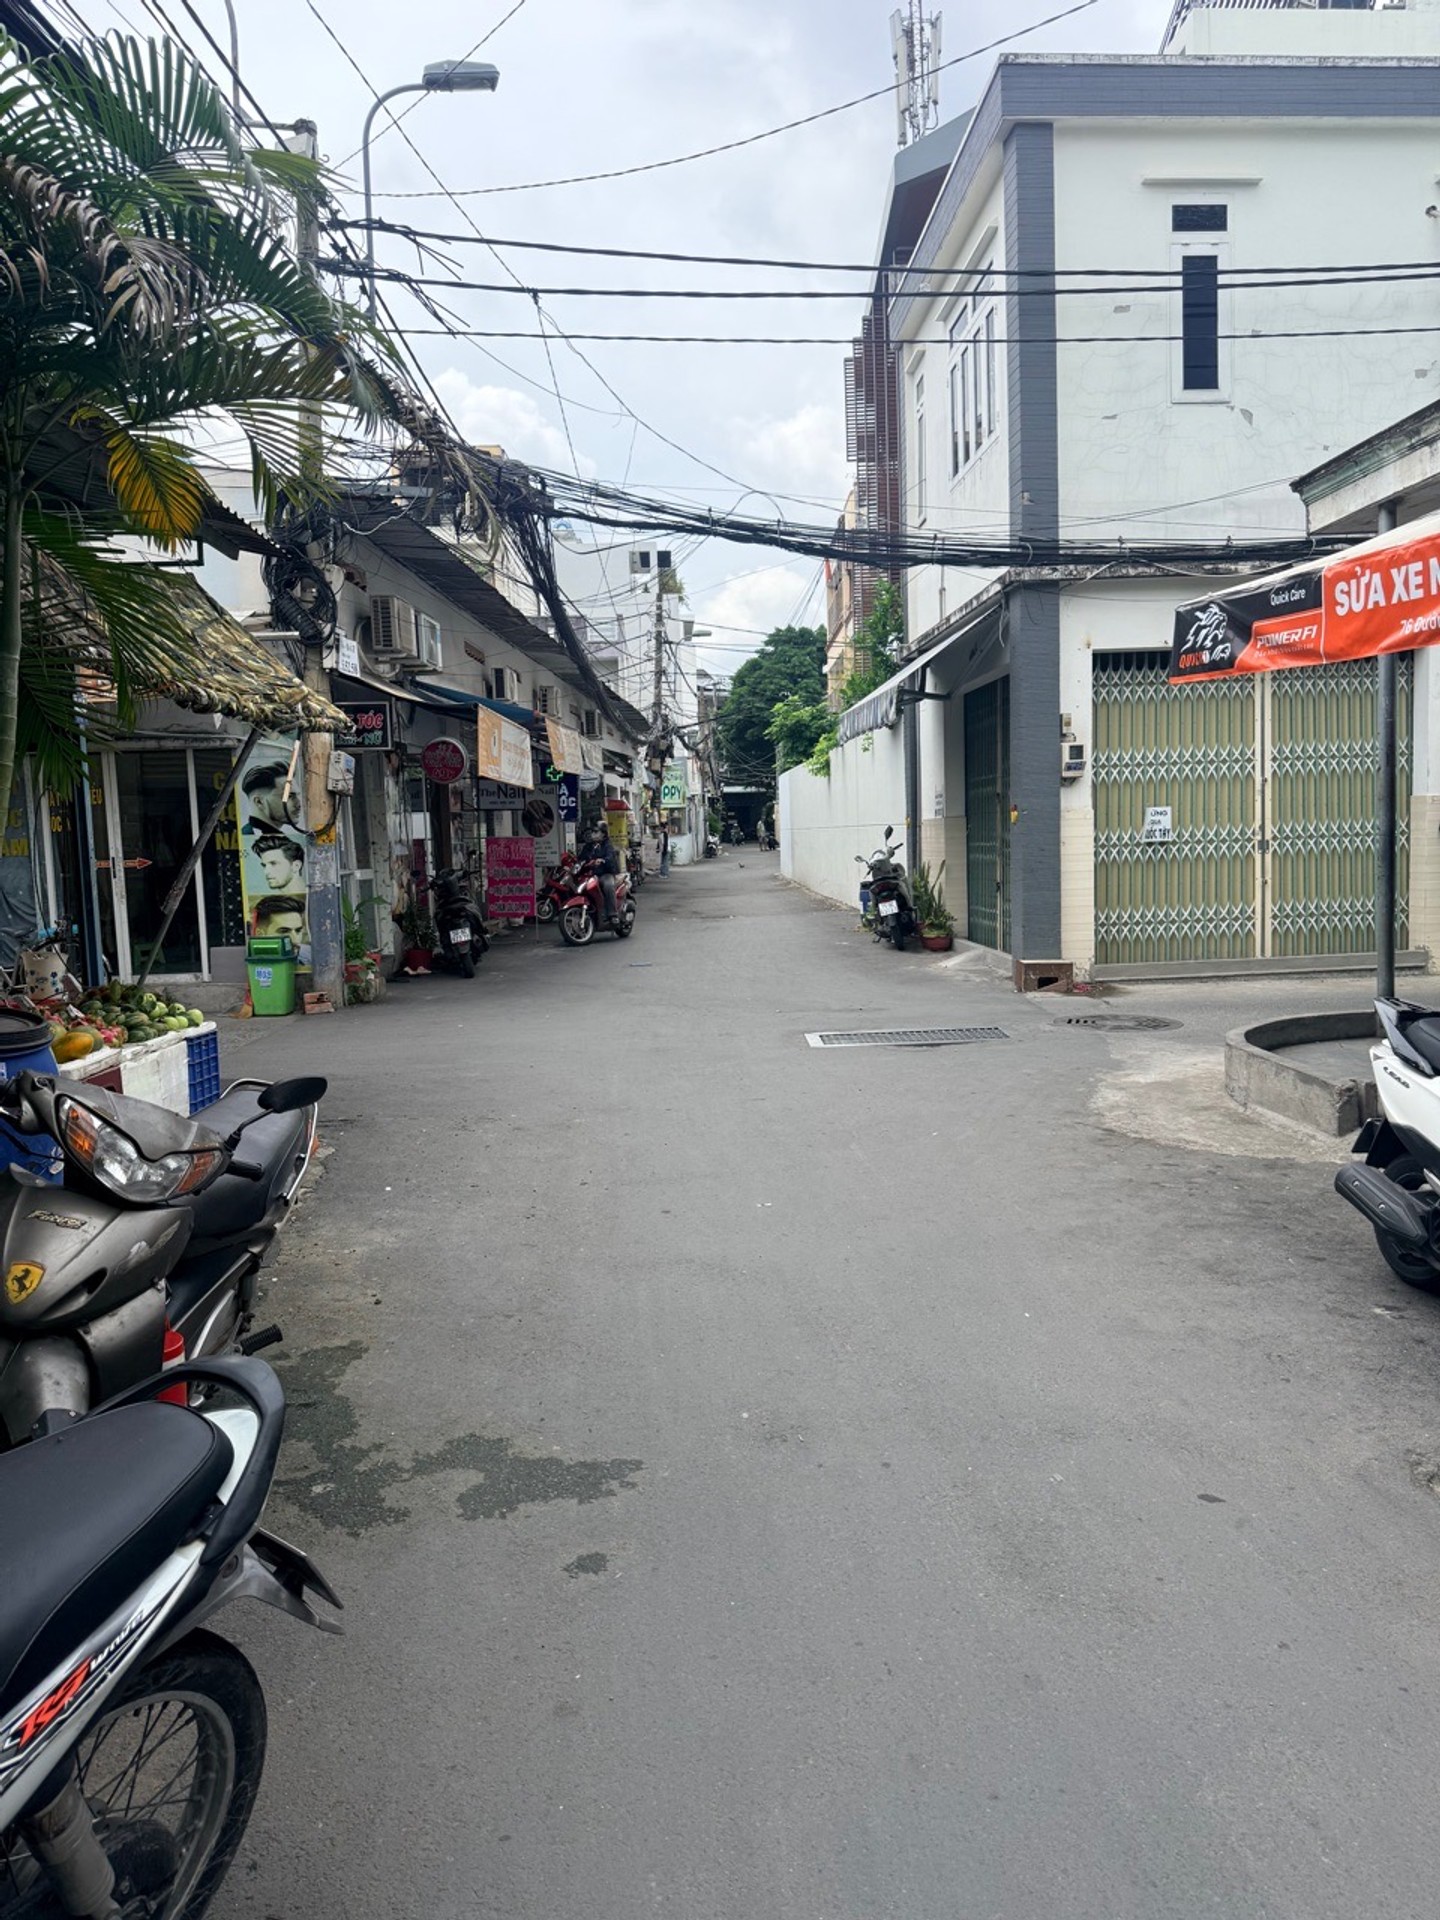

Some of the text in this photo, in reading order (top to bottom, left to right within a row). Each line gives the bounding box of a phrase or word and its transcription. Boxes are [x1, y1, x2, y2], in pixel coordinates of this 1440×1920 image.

[1270, 588, 1306, 606] Quick Care
[1334, 566, 1386, 617] SỬA
[1390, 561, 1424, 605] XE
[356, 710, 384, 729] TÓC
[480, 784, 526, 799] The Nail
[1383, 1066, 1410, 1089] LEAD
